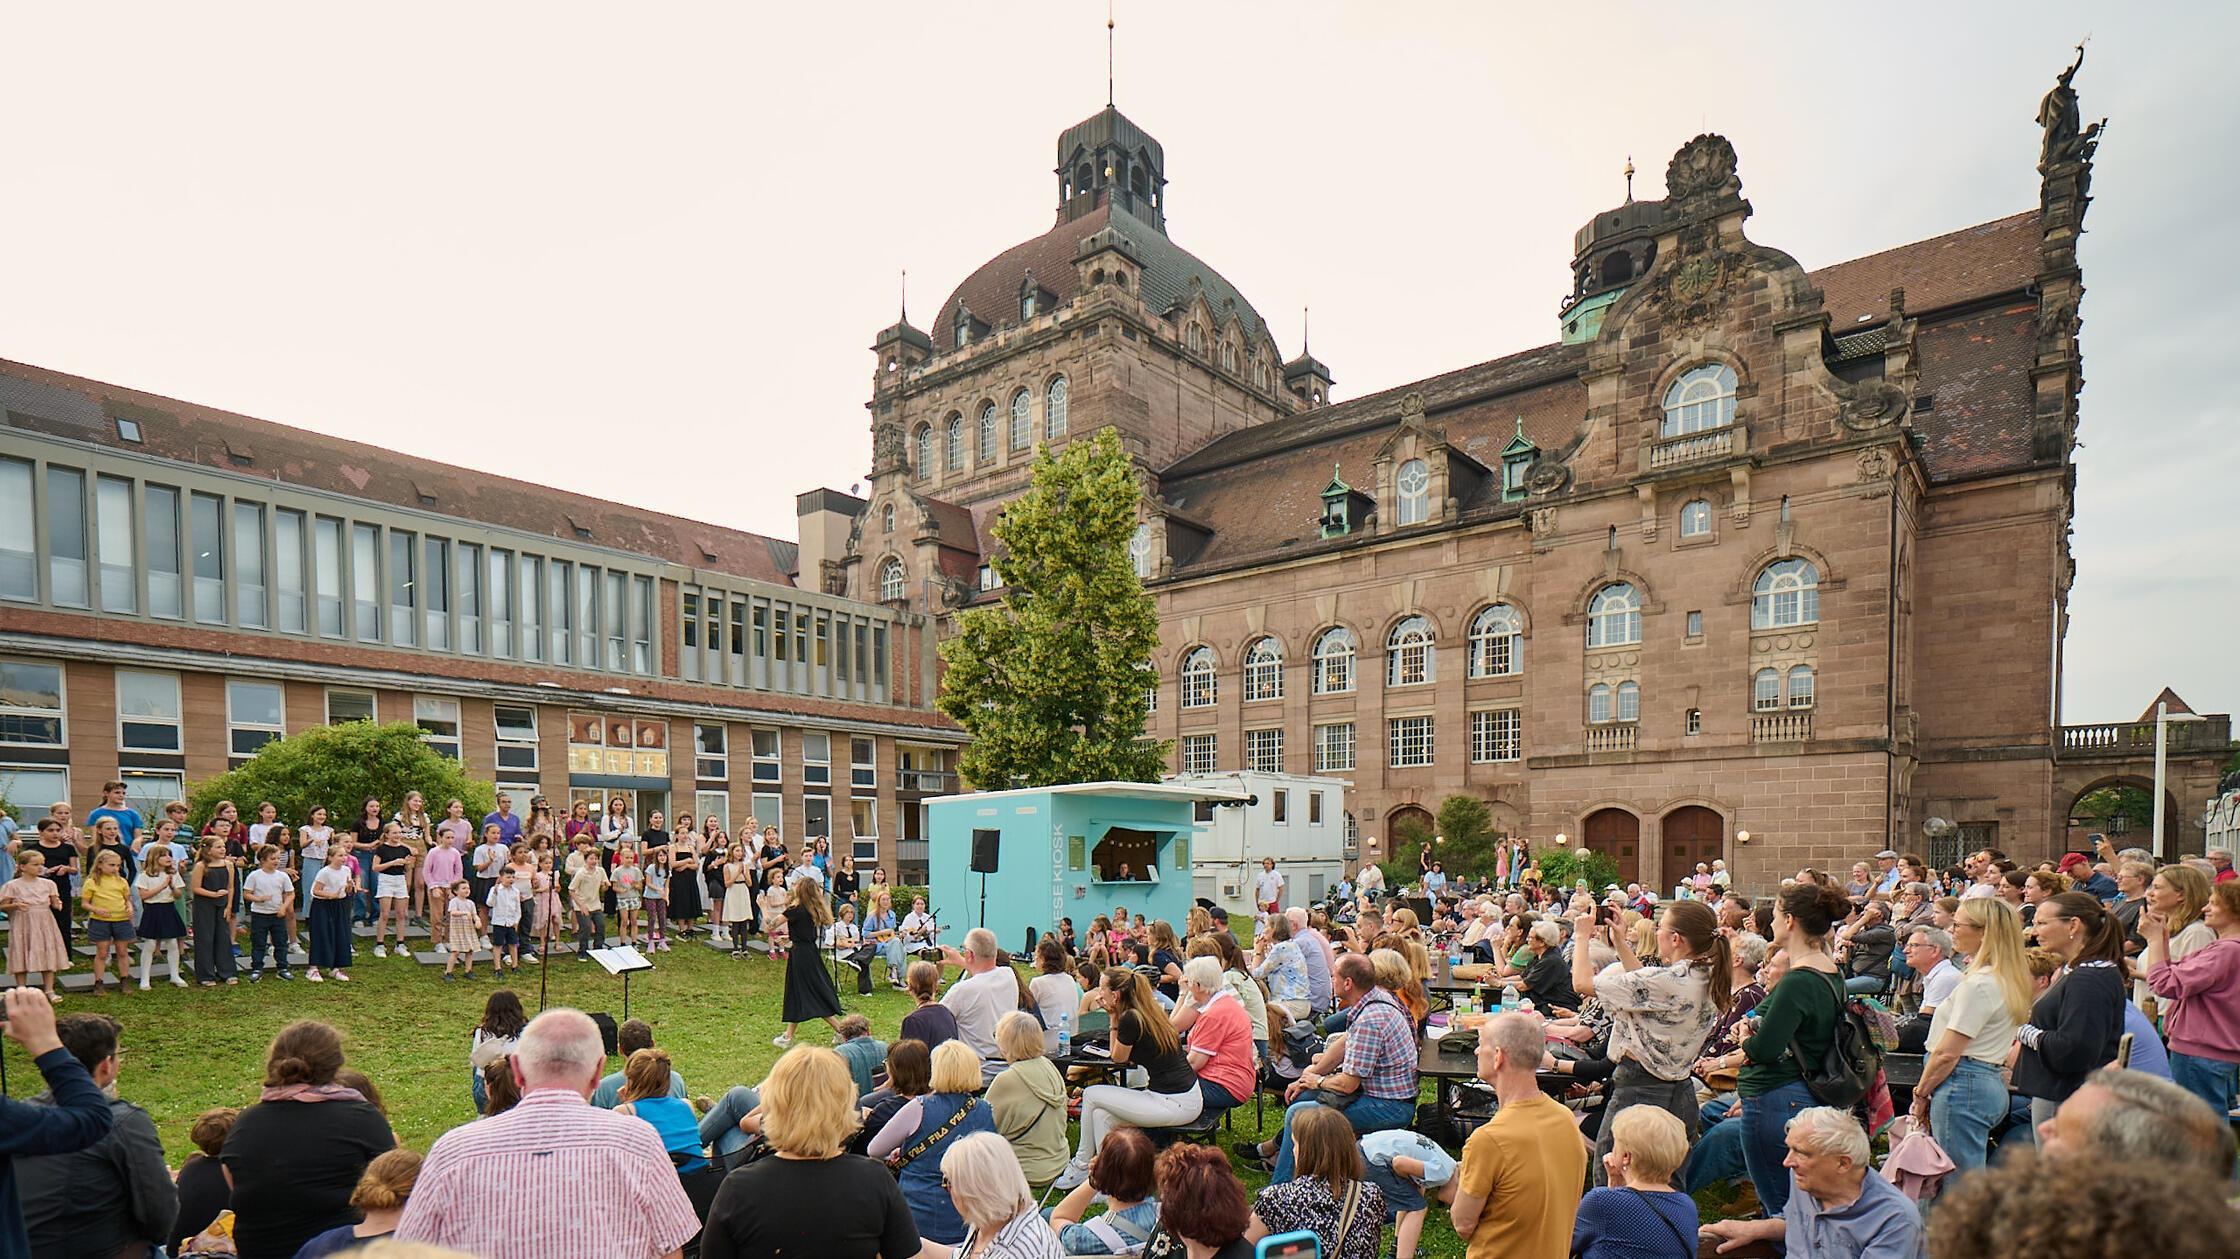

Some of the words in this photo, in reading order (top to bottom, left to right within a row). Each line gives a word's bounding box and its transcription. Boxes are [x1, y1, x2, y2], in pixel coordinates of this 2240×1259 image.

[1053, 823, 1064, 882] KIOSK
[908, 1142, 926, 1158] FILA
[928, 1127, 949, 1144] FILA
[949, 1109, 967, 1126] FILA
